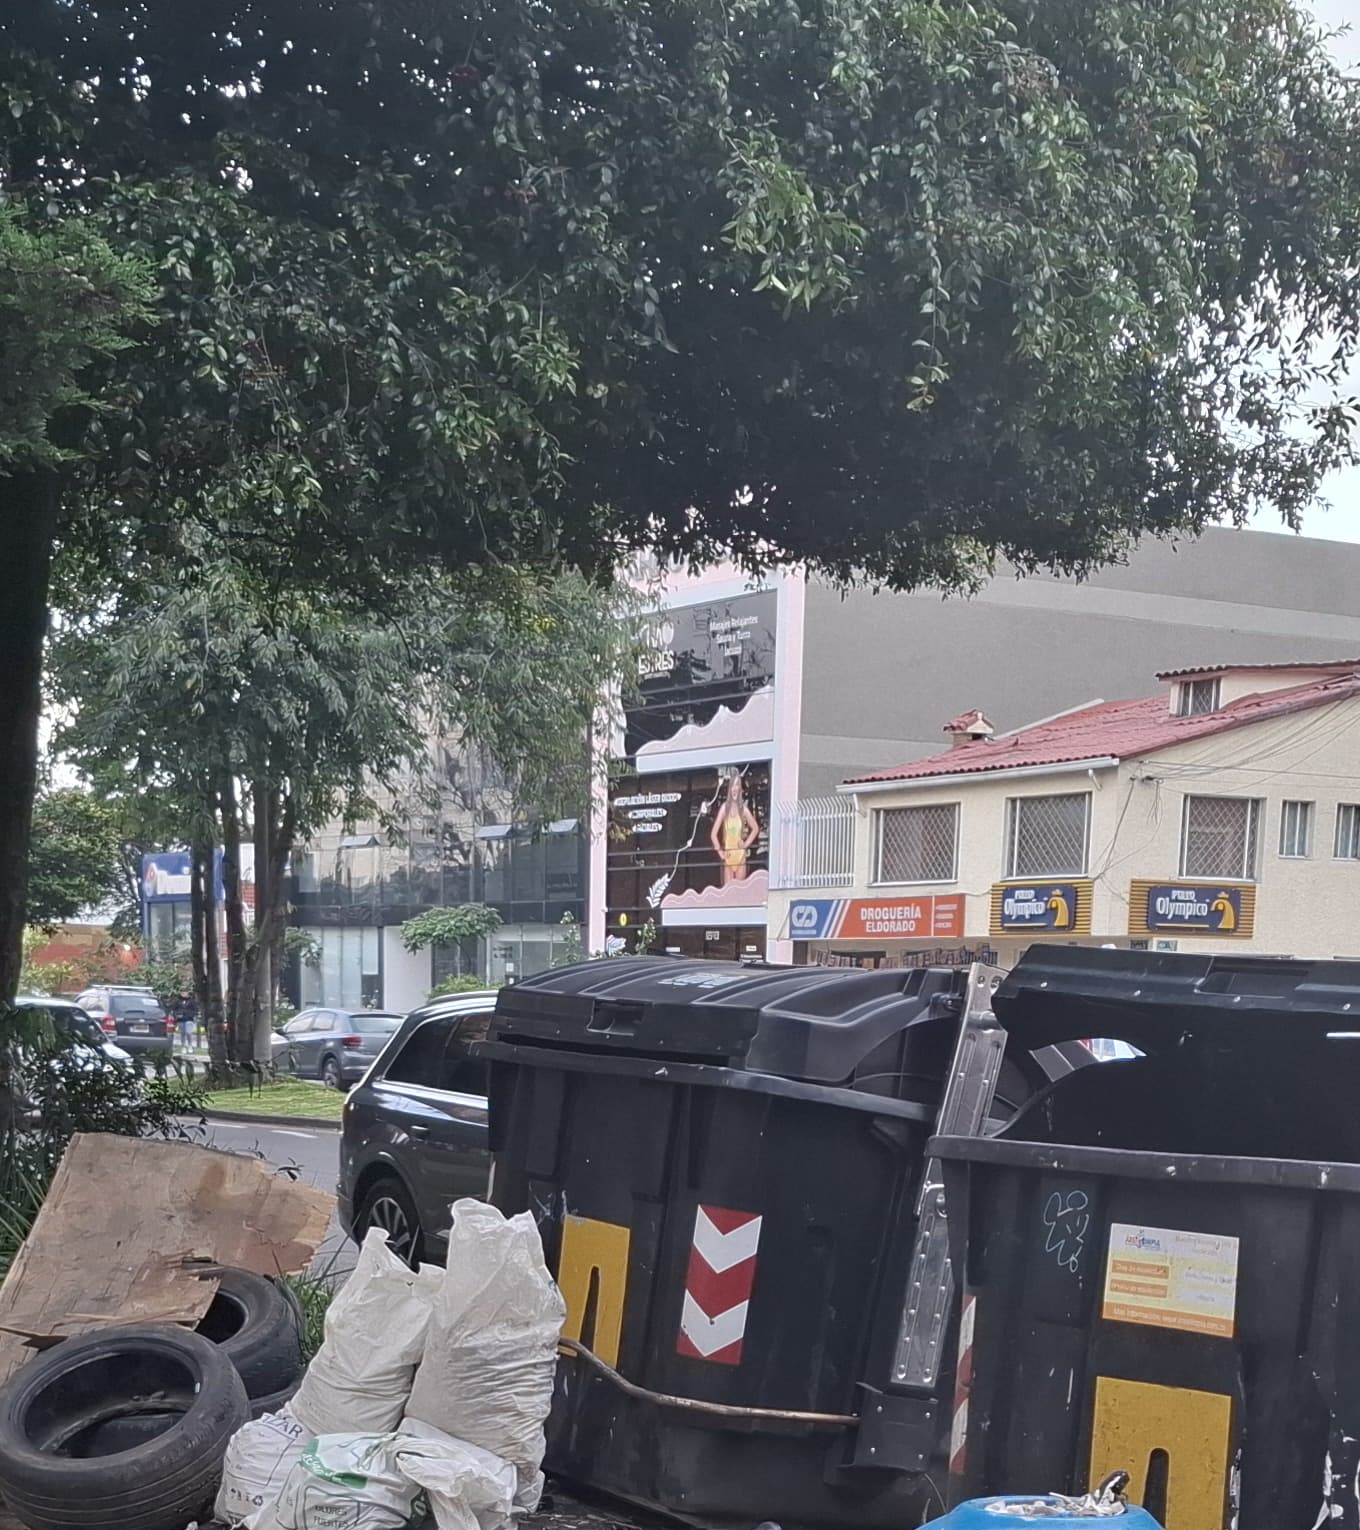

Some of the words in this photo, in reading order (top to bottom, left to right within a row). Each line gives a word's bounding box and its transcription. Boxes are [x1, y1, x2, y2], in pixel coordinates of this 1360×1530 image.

[860, 903, 922, 921] DROGUERÍA
[1004, 898, 1046, 920] Olympico
[1156, 897, 1208, 920] Olympico
[866, 920, 915, 933] ELDORADO
